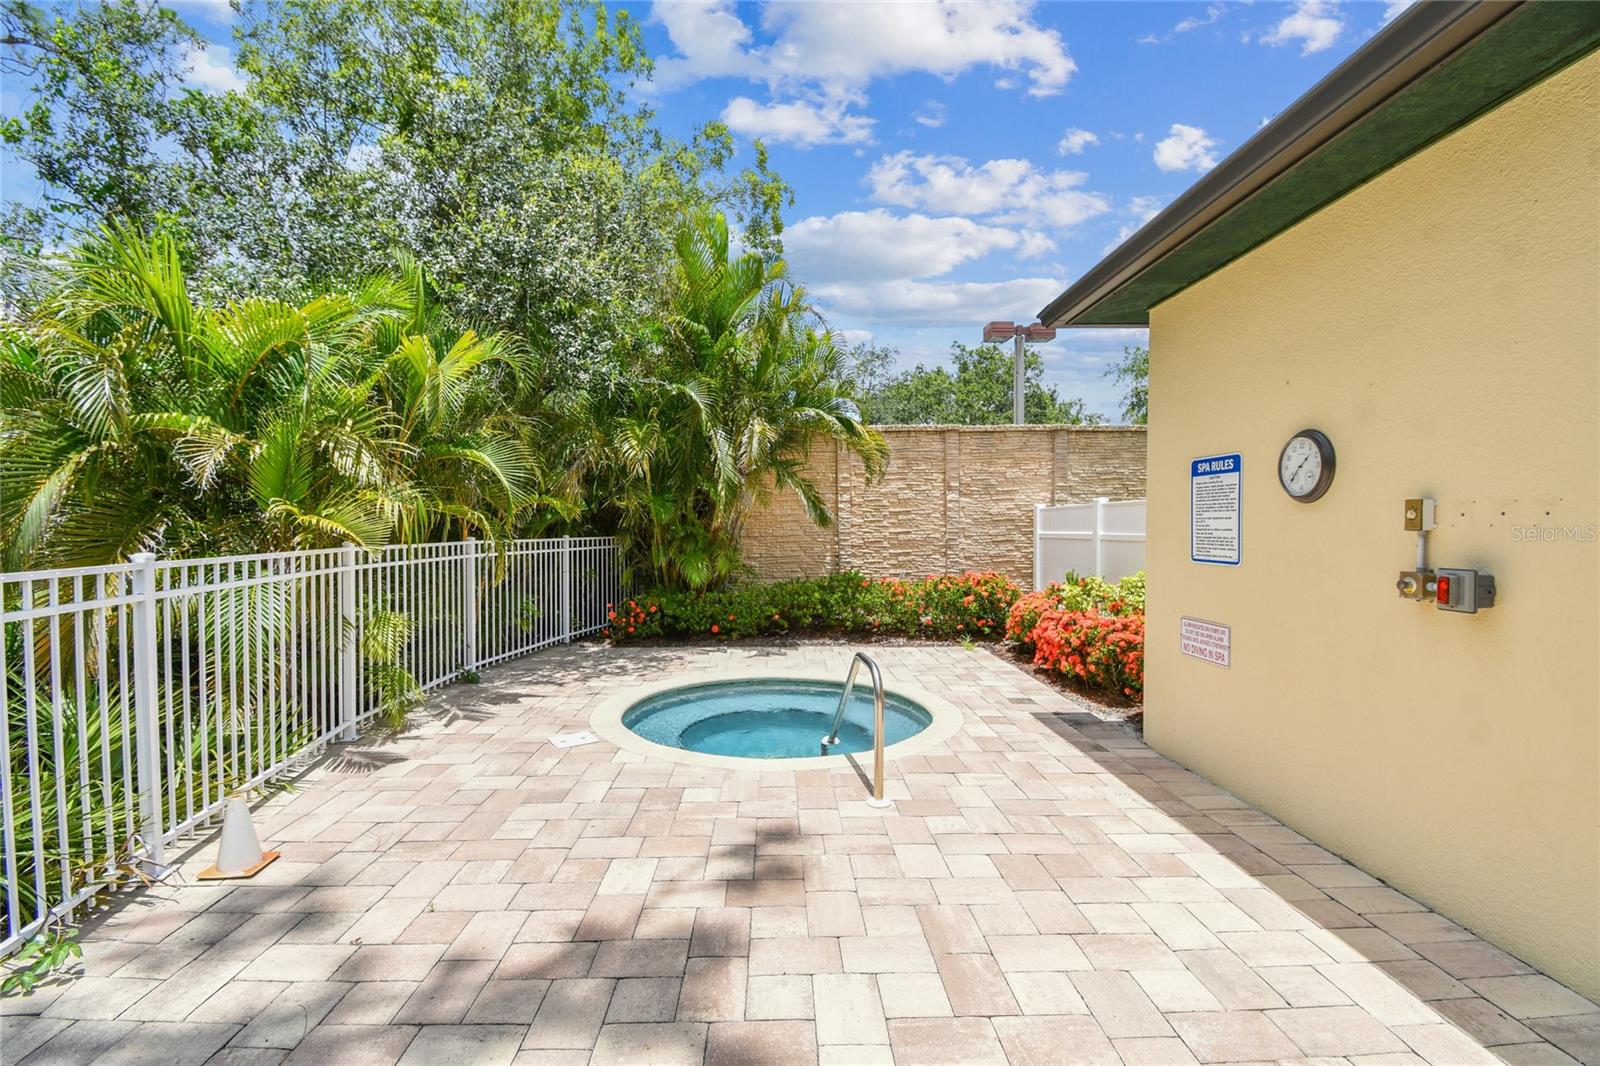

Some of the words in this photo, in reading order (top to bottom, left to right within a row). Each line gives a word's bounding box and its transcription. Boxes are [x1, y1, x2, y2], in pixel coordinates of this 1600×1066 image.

[1198, 462, 1210, 473] SPA
[1211, 459, 1234, 471] RULES
[1183, 643, 1190, 652] NO
[1191, 645, 1207, 657] DIVING
[1208, 649, 1214, 659] IN
[1215, 651, 1225, 662] SPA
